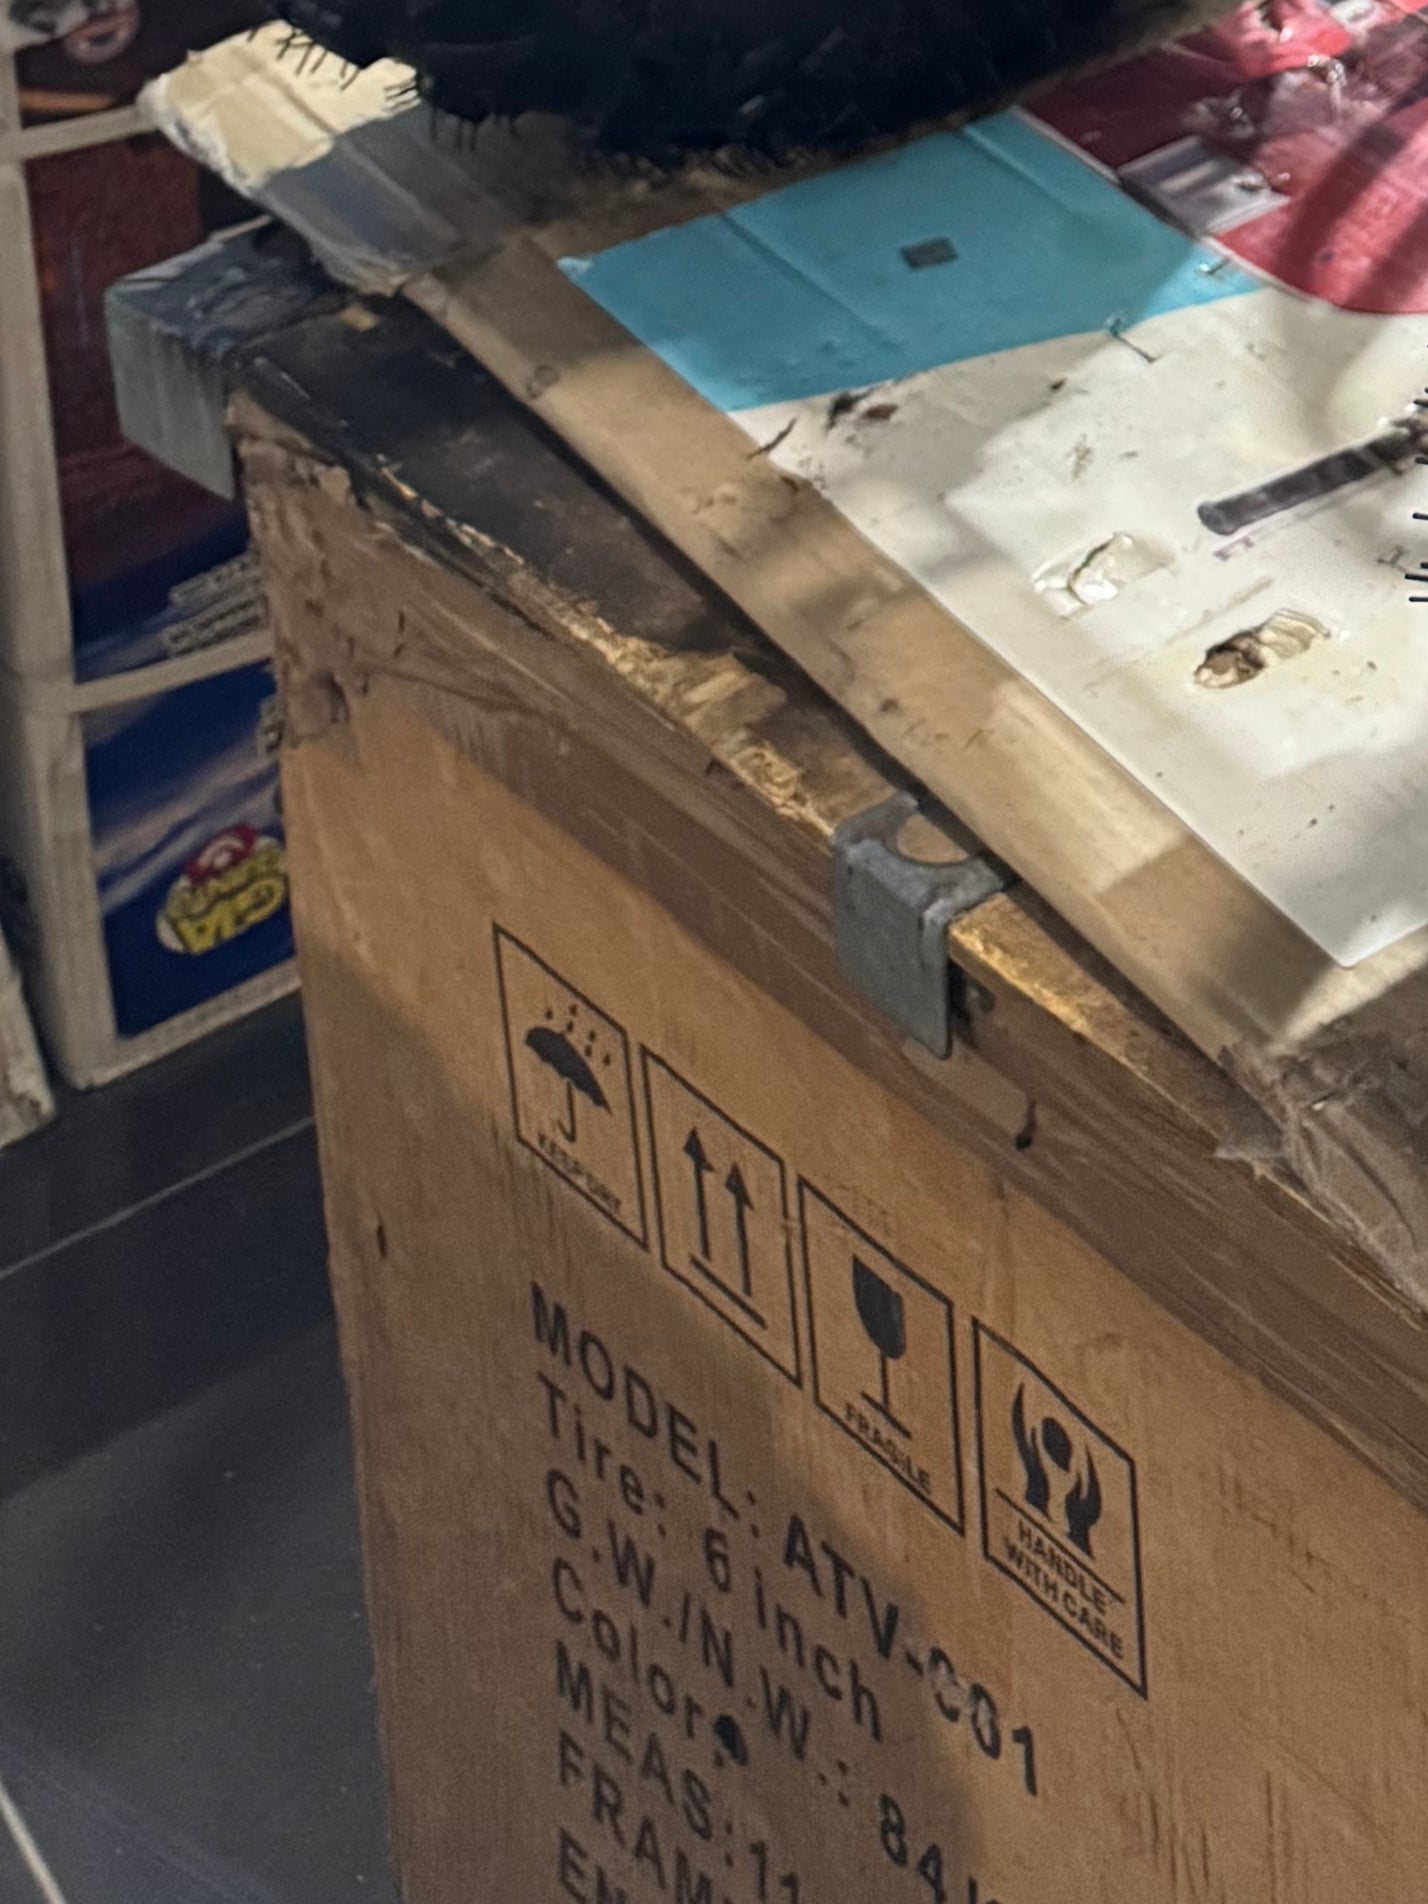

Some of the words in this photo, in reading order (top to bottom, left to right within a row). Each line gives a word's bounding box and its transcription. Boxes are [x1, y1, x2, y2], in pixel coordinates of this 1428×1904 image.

[530, 1279, 759, 1538] MODEL:
[704, 1527, 732, 1593] 6
[753, 1565, 882, 1743] inch
[1018, 1519, 1108, 1616] HANDLE
[1060, 1592, 1125, 1660] CARE
[559, 1727, 733, 1904] FRAM
